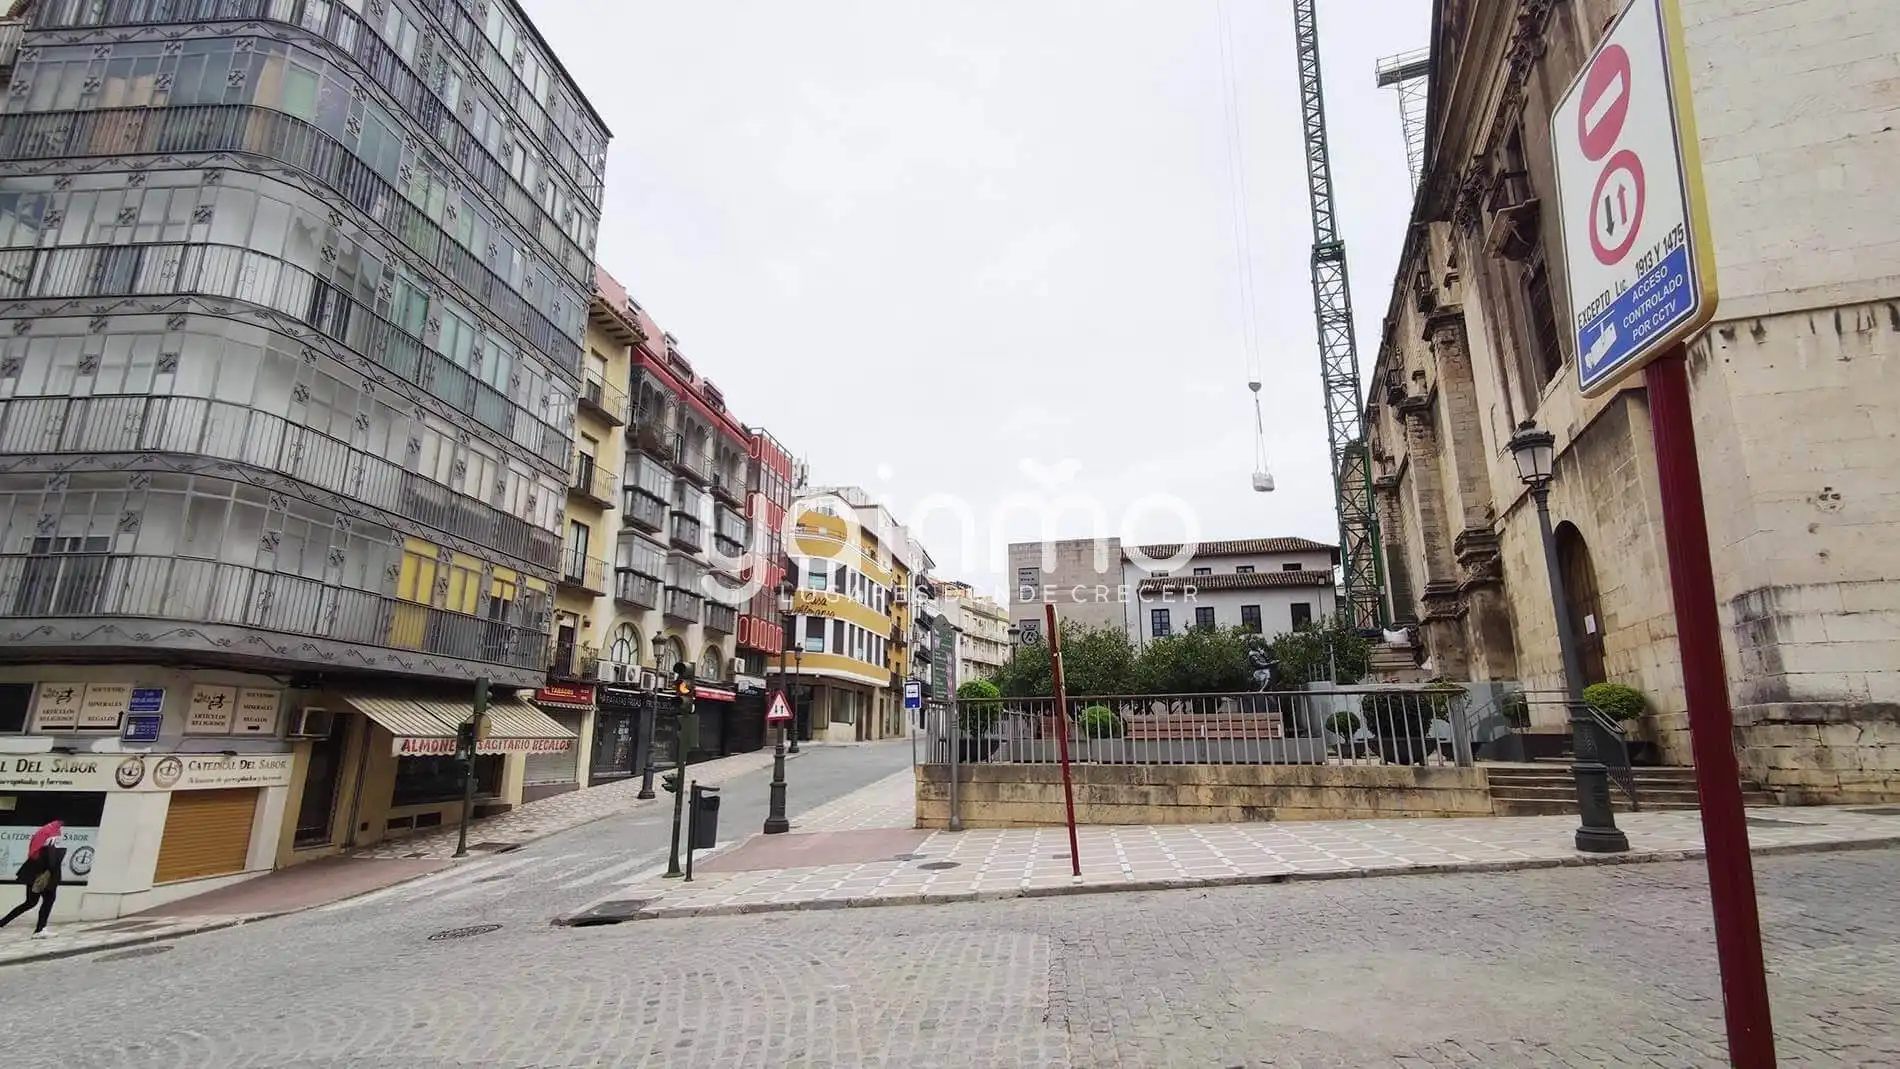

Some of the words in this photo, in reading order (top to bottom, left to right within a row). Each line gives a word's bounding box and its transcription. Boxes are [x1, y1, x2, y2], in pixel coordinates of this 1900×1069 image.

[1577, 289, 1611, 329] EXCEPTO
[1635, 250, 1652, 278] 1913
[1653, 241, 1661, 262] Y
[1663, 222, 1684, 255] 1475
[1632, 265, 1668, 302] ACCESO
[1622, 273, 1683, 328] CONTROLADO
[1632, 317, 1651, 341] POR
[1652, 299, 1677, 327] CCTV
[401, 738, 457, 753] ALMONE
[477, 738, 530, 751] SAGITARIO
[531, 738, 571, 751] REGALOS
